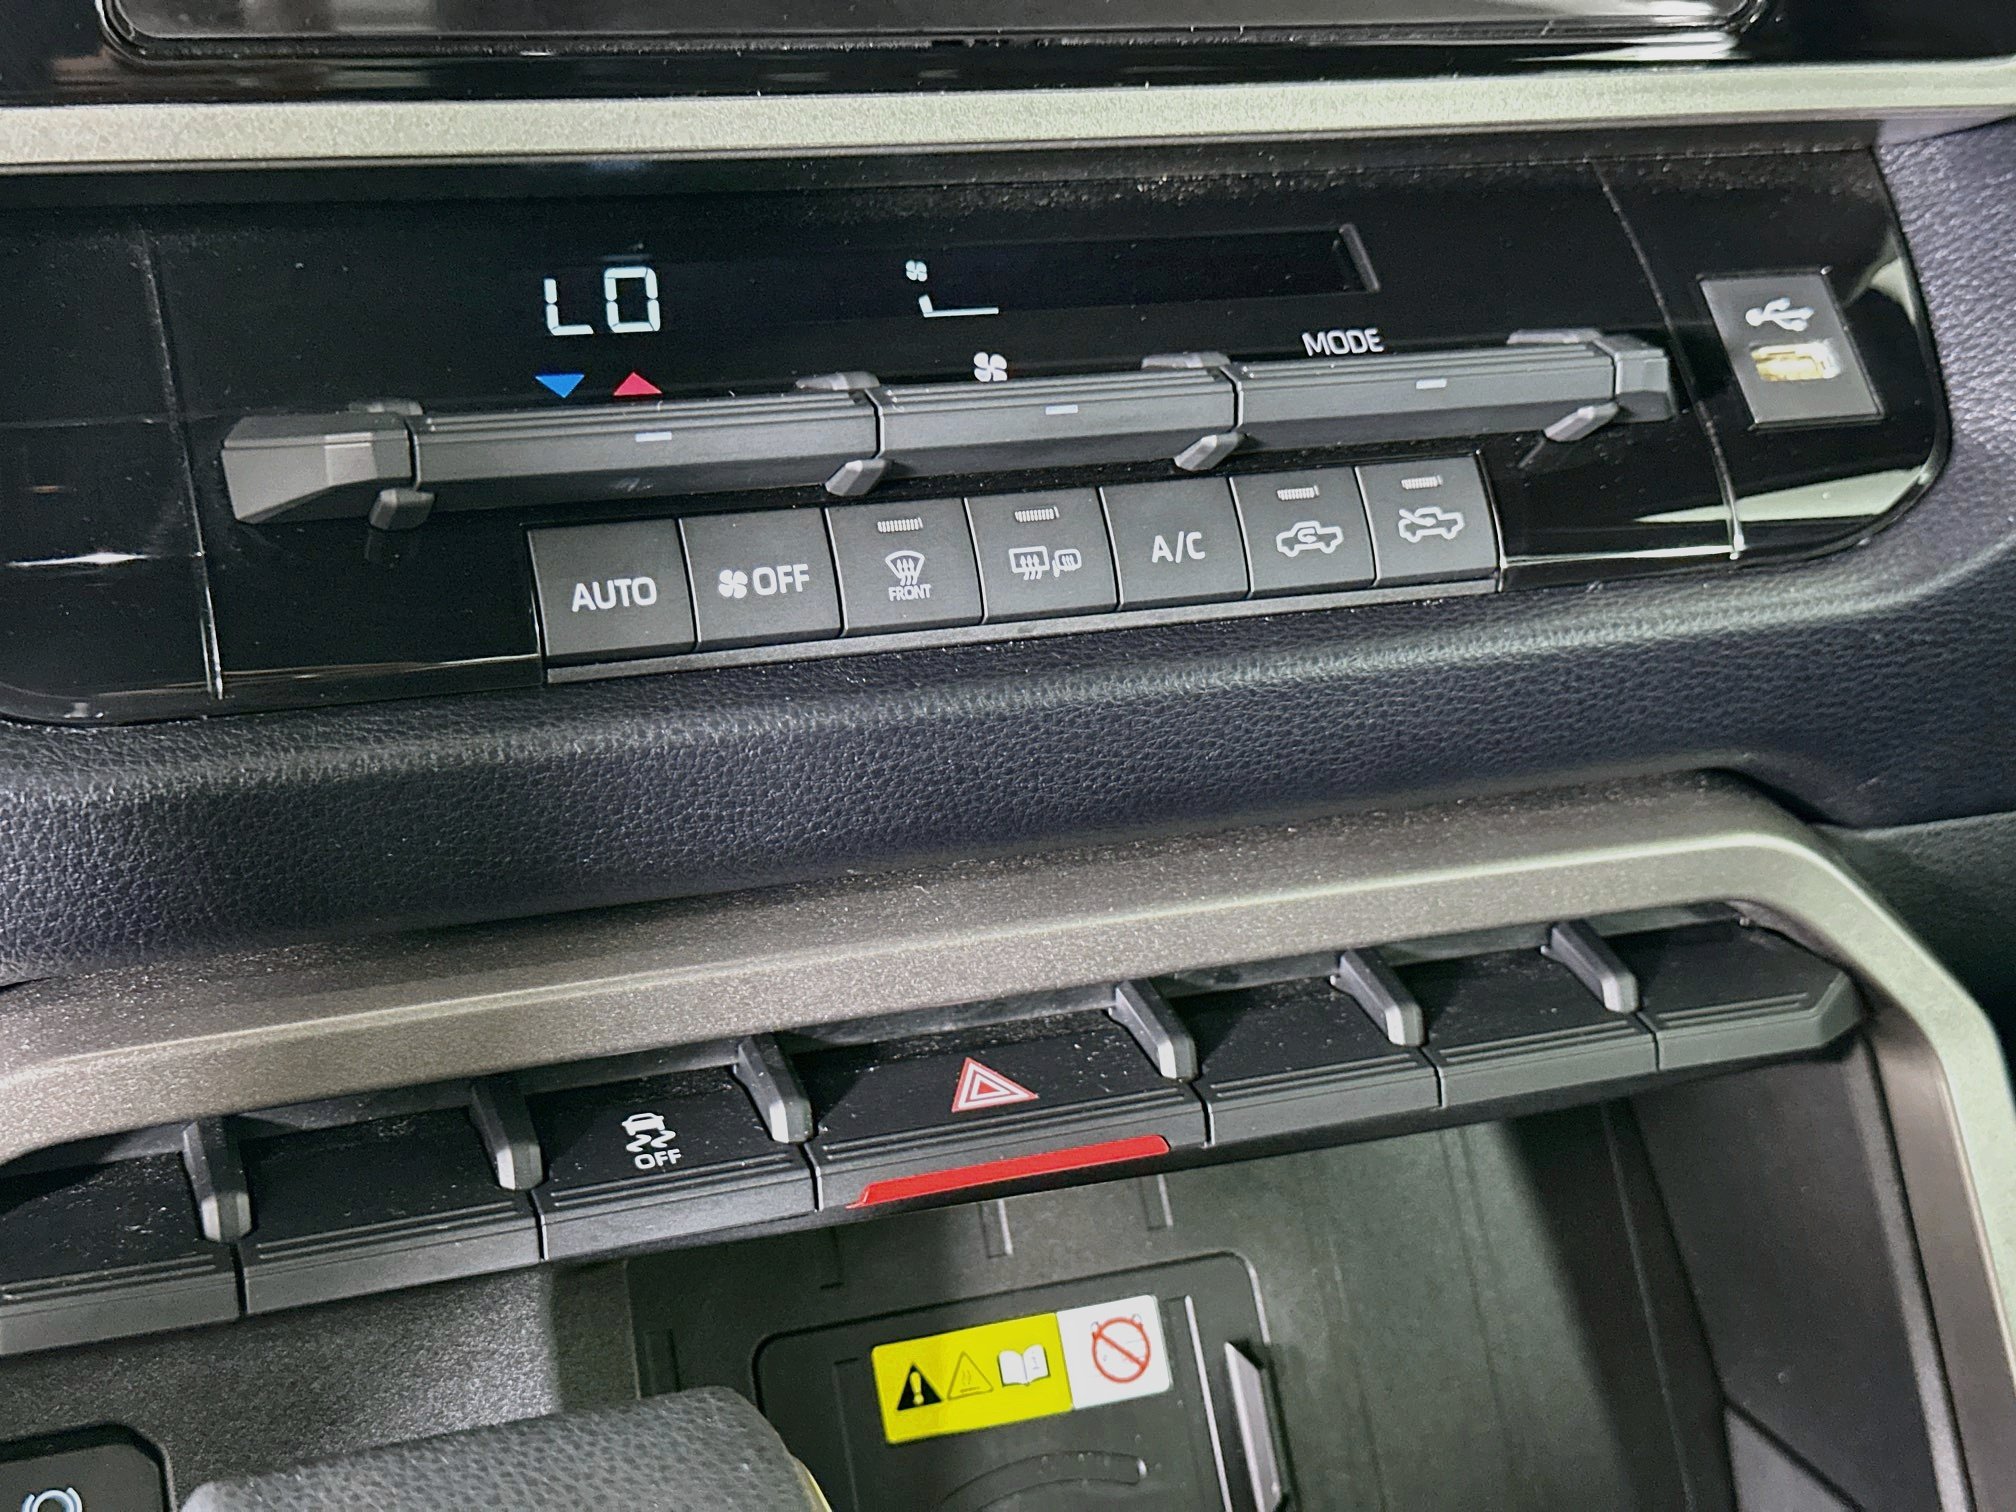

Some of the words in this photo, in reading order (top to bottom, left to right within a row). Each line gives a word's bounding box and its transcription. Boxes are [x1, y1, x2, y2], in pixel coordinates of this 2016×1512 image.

[545, 266, 661, 336] LO
[1302, 327, 1385, 357] MODE
[1151, 530, 1206, 564] A/C
[571, 576, 658, 613] AUTO
[752, 563, 810, 596] OFF
[888, 582, 932, 602] FRONT
[634, 1148, 682, 1170] OFF
